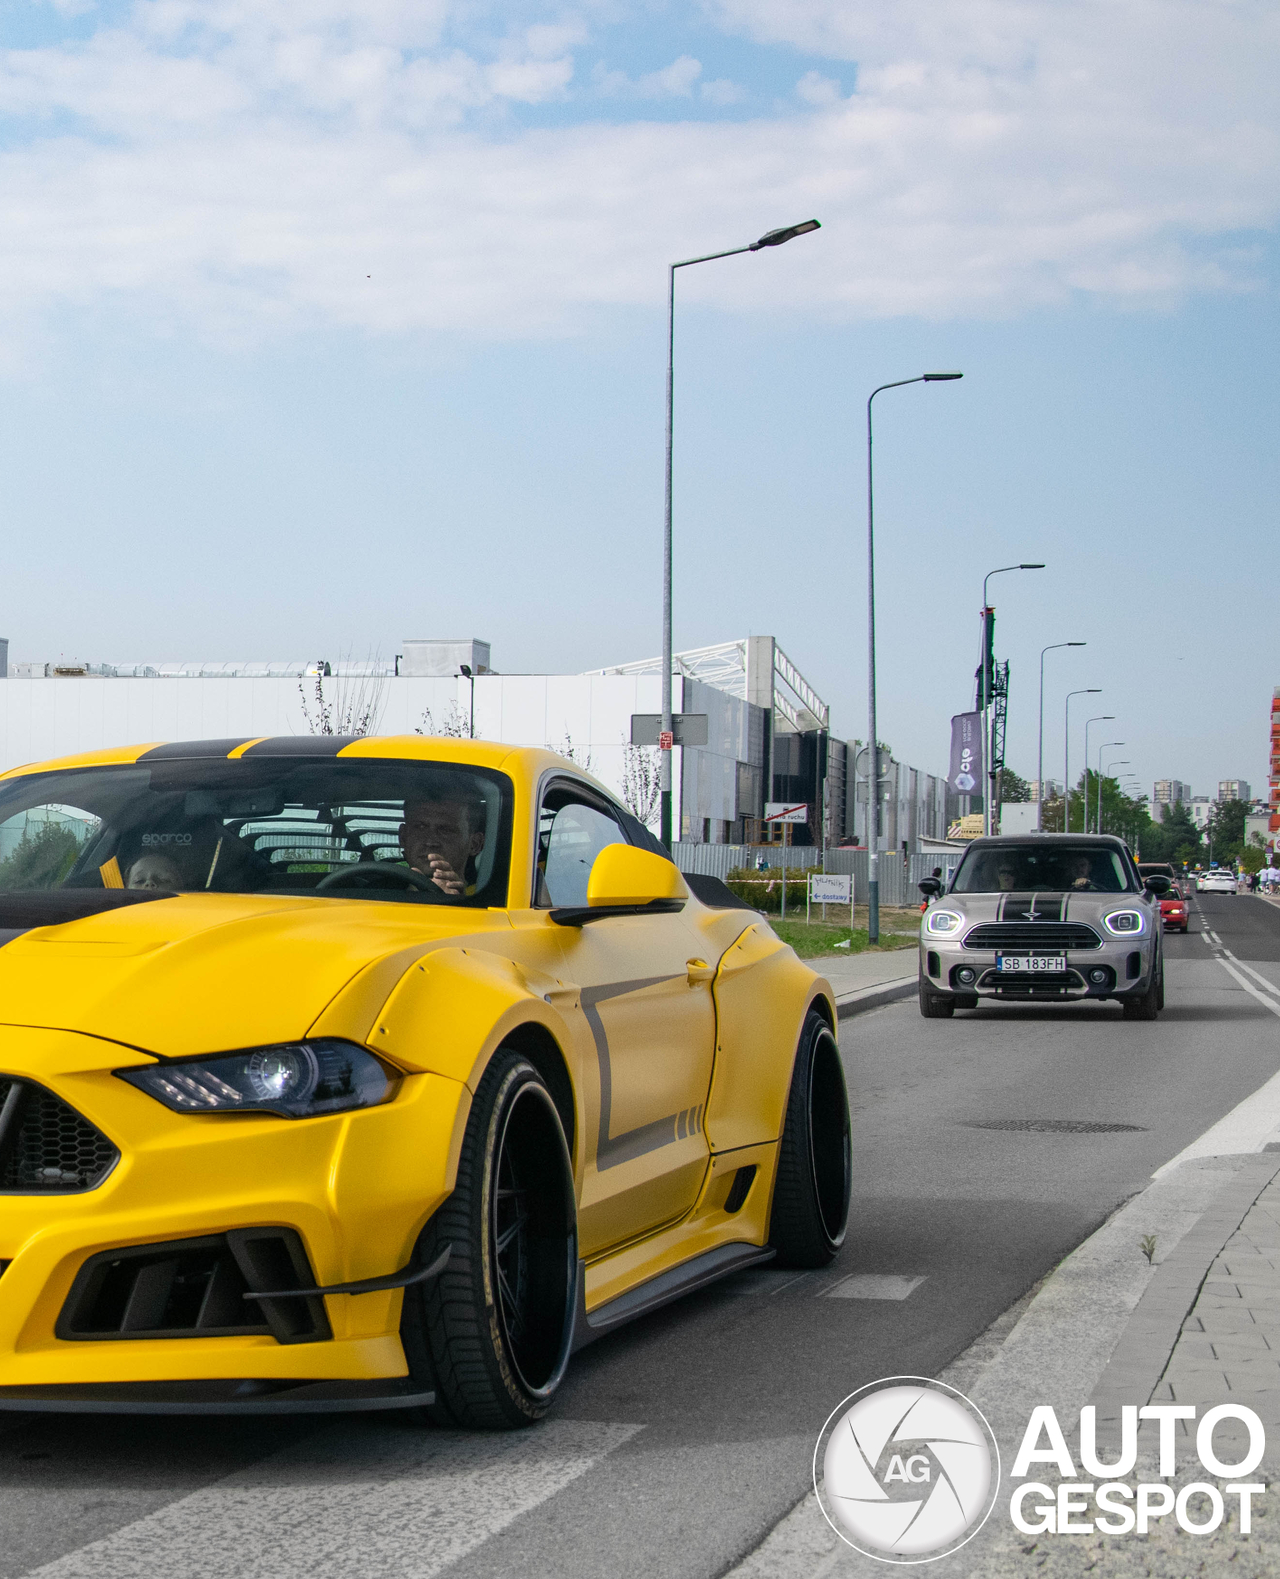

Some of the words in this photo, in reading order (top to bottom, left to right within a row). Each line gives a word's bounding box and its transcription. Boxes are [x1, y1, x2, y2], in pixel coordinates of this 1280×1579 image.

[142, 833, 192, 846] sparco
[822, 893, 847, 902] dostawy
[1004, 958, 1020, 969] SB
[1025, 958, 1063, 969] 183FH
